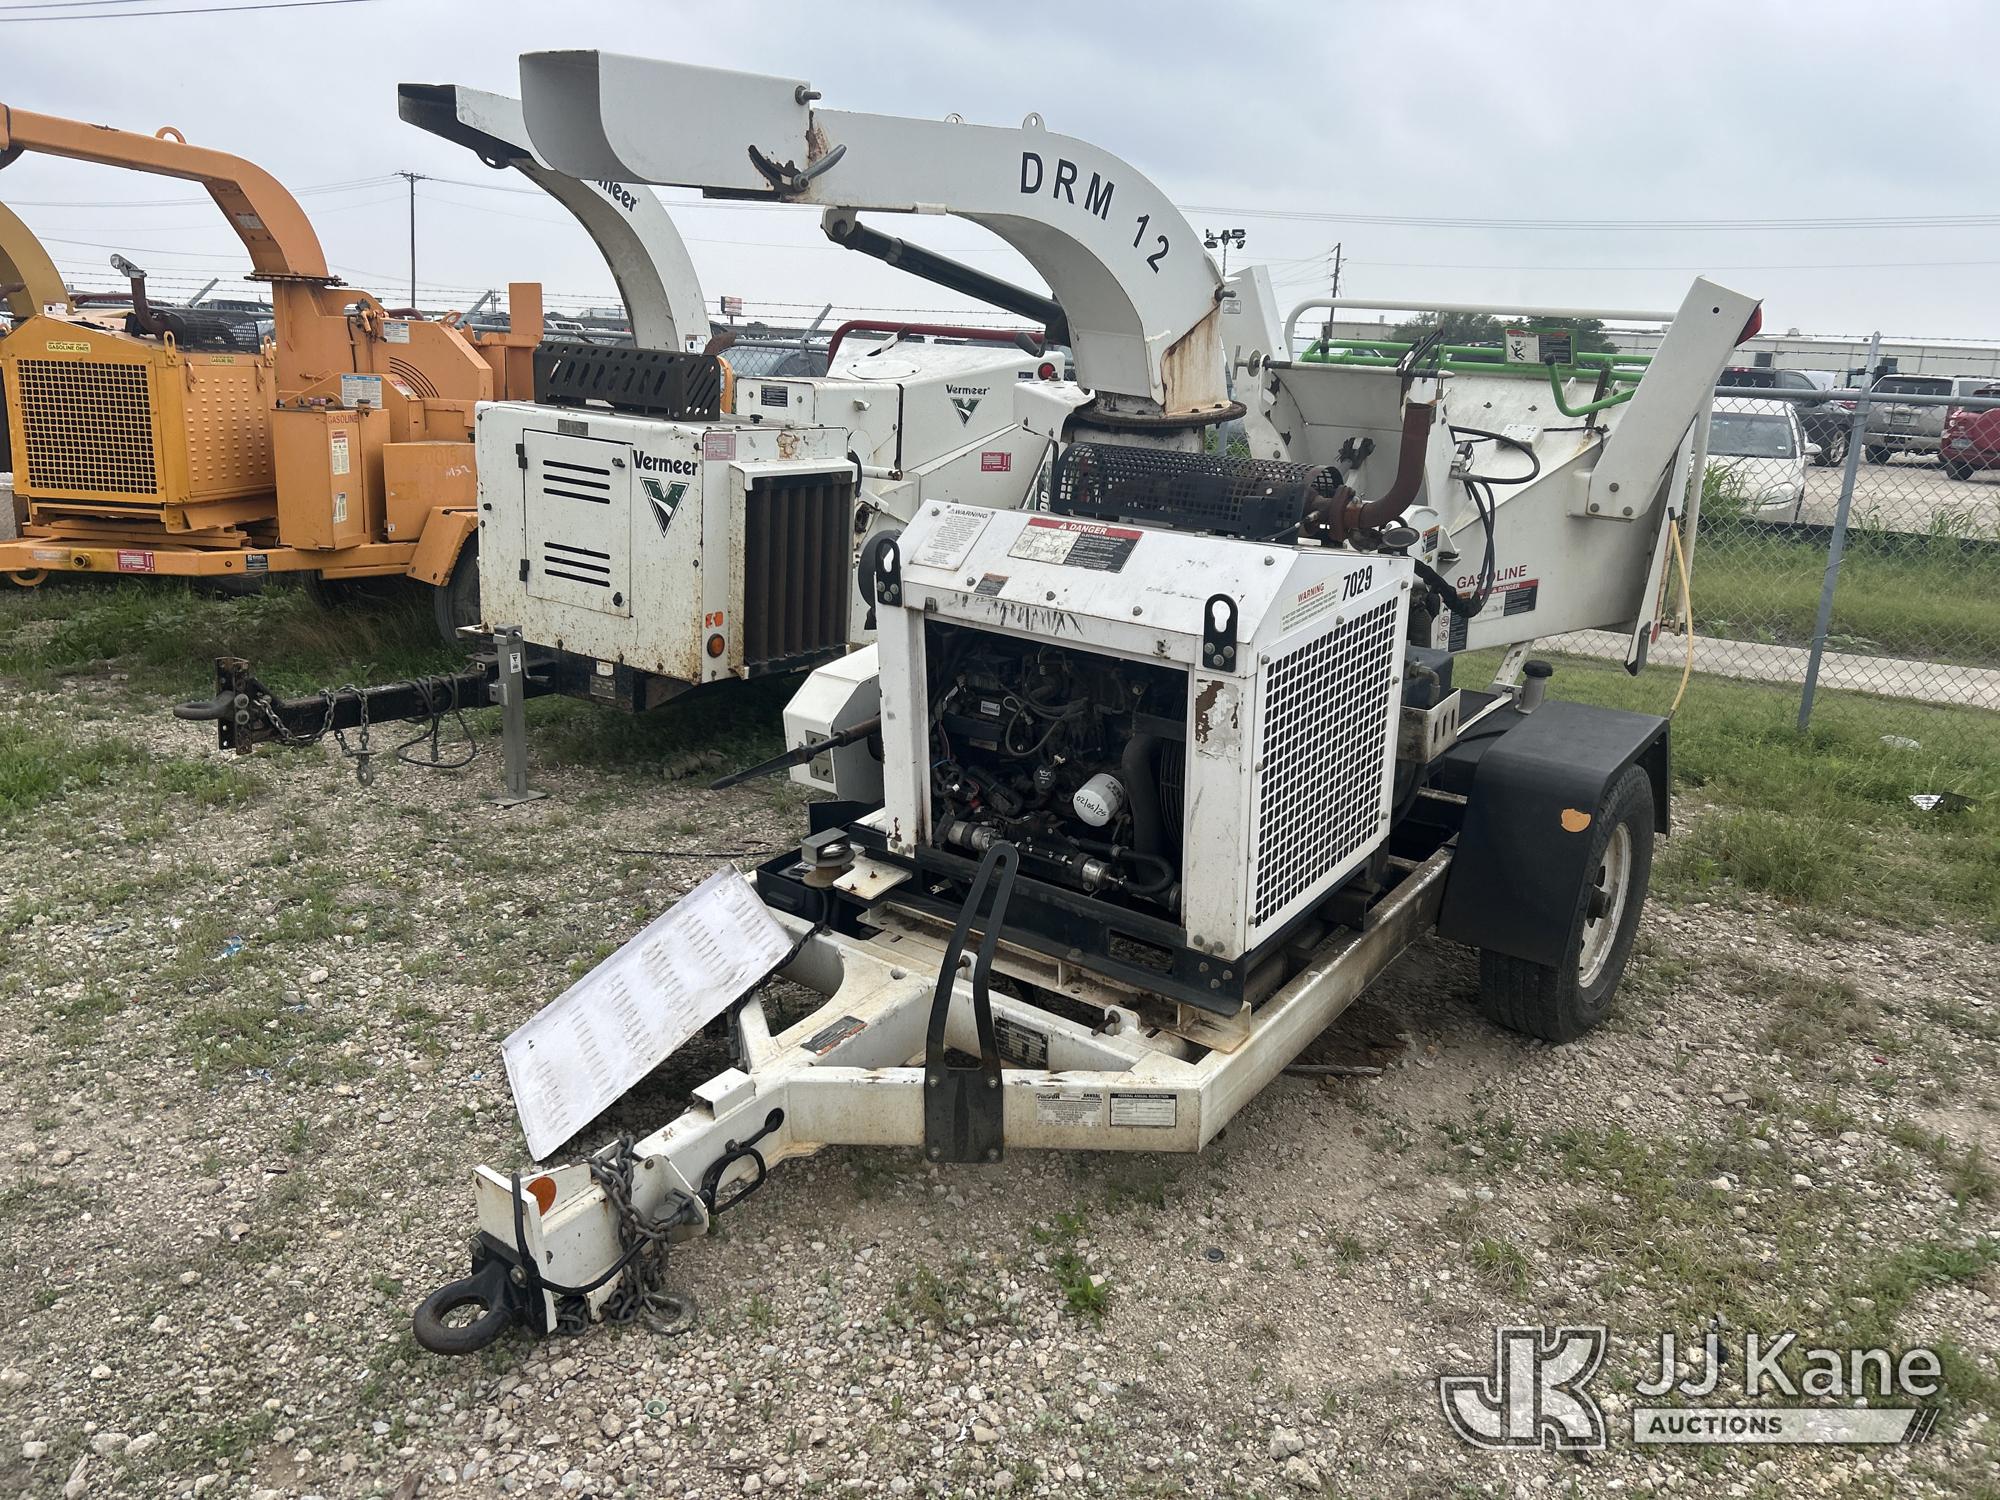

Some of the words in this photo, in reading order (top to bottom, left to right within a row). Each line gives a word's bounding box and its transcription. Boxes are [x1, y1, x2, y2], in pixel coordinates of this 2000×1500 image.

[1021, 152, 1115, 221] DRM
[946, 384, 988, 396] Vermeer
[327, 414, 359, 424] GASOLINE
[632, 449, 698, 476] Vermeer
[955, 510, 988, 519] WARNING
[1069, 524, 1108, 535] DANGER
[1342, 565, 1373, 601] 7029
[1498, 583, 1521, 592] DANGER
[1297, 582, 1325, 602] WARNING
